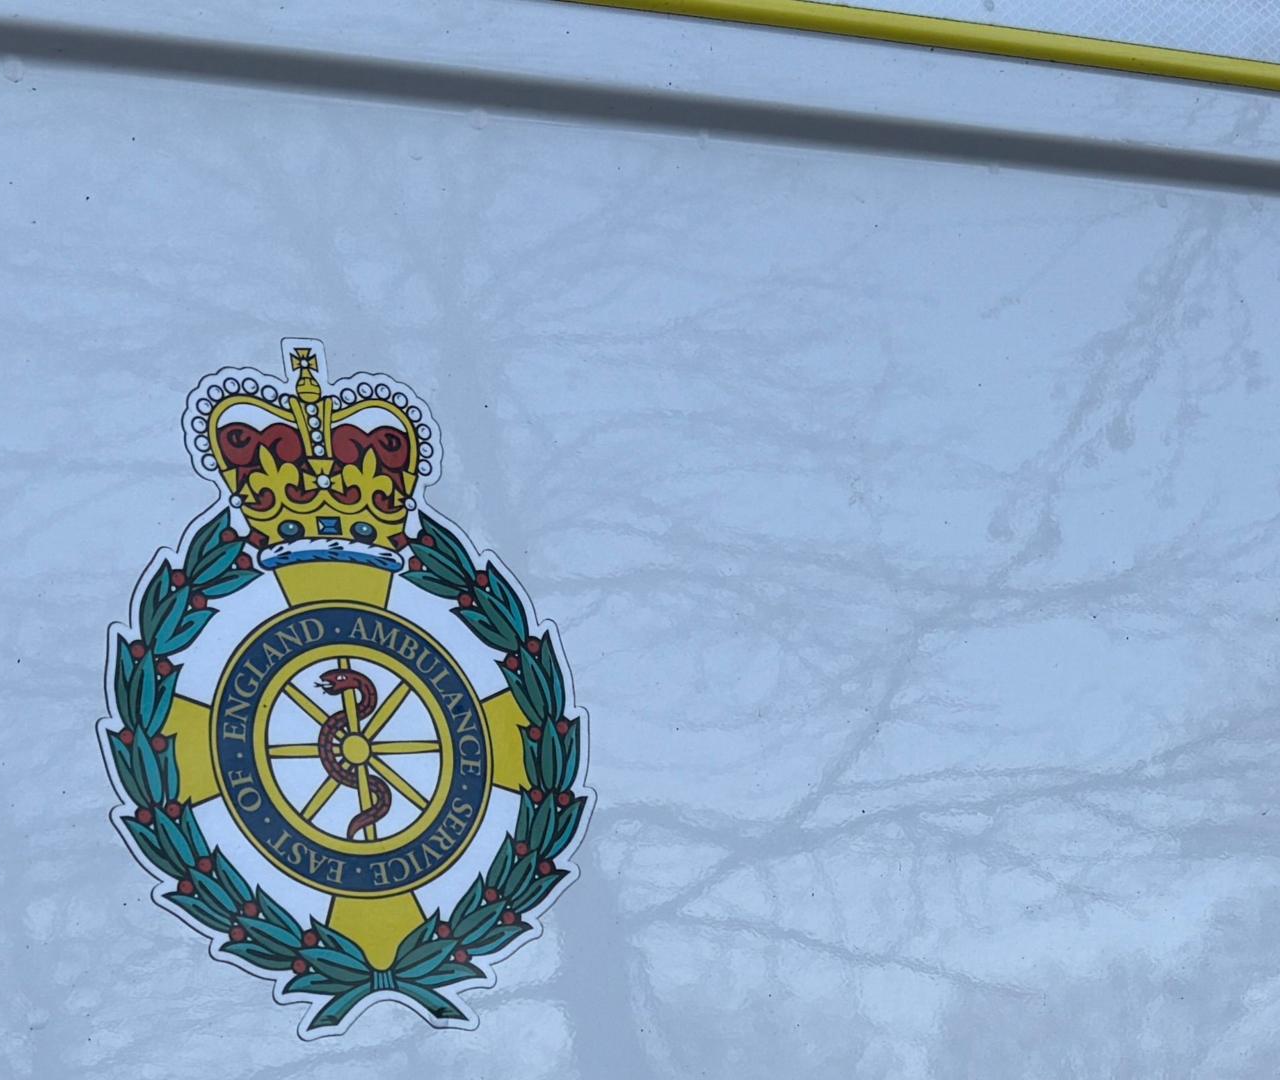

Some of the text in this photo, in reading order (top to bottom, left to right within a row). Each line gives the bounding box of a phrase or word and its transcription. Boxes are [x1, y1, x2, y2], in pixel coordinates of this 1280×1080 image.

[223, 616, 482, 886] EAST OF ENGLAND AMBULANCE SERVICE
